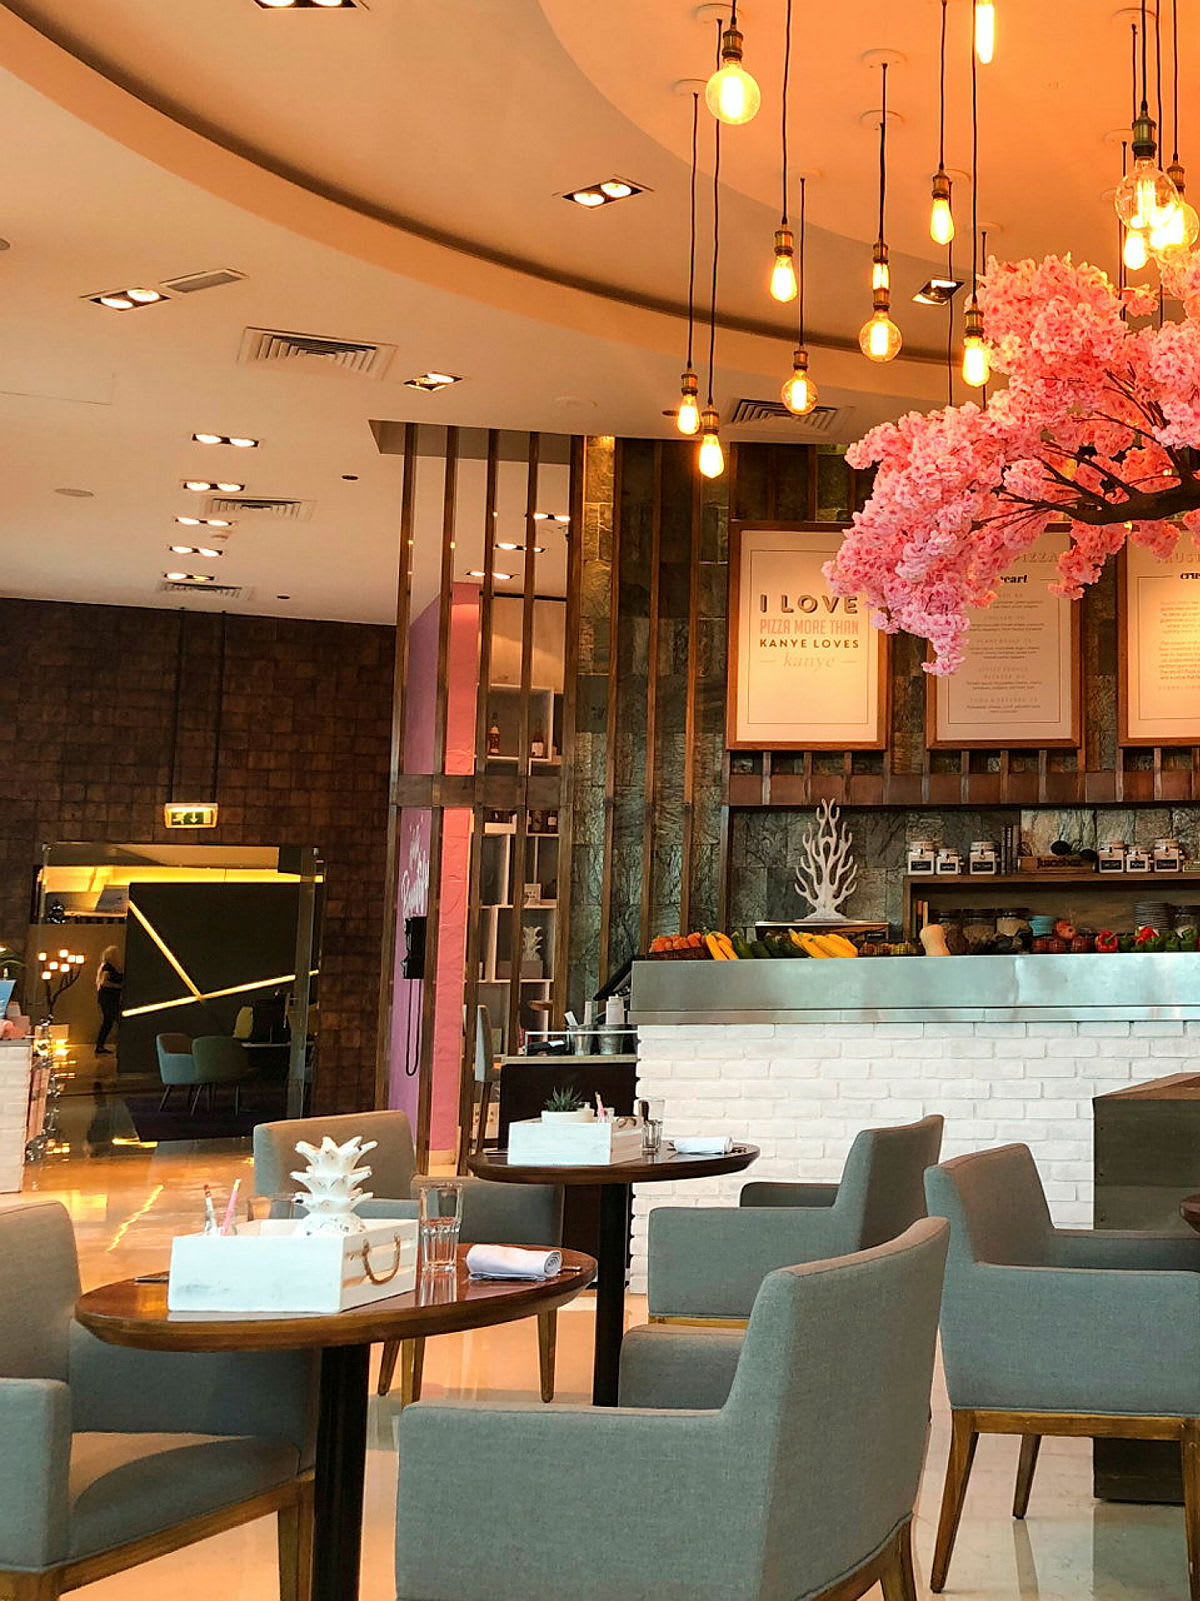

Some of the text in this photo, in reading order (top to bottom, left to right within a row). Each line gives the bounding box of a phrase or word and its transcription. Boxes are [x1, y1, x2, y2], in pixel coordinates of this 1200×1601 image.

[760, 594, 859, 615] I LOVE
[760, 619, 859, 635] PIZZA MORE THAN
[760, 639, 859, 649] KANYE LOVES
[782, 652, 836, 672] kanye
